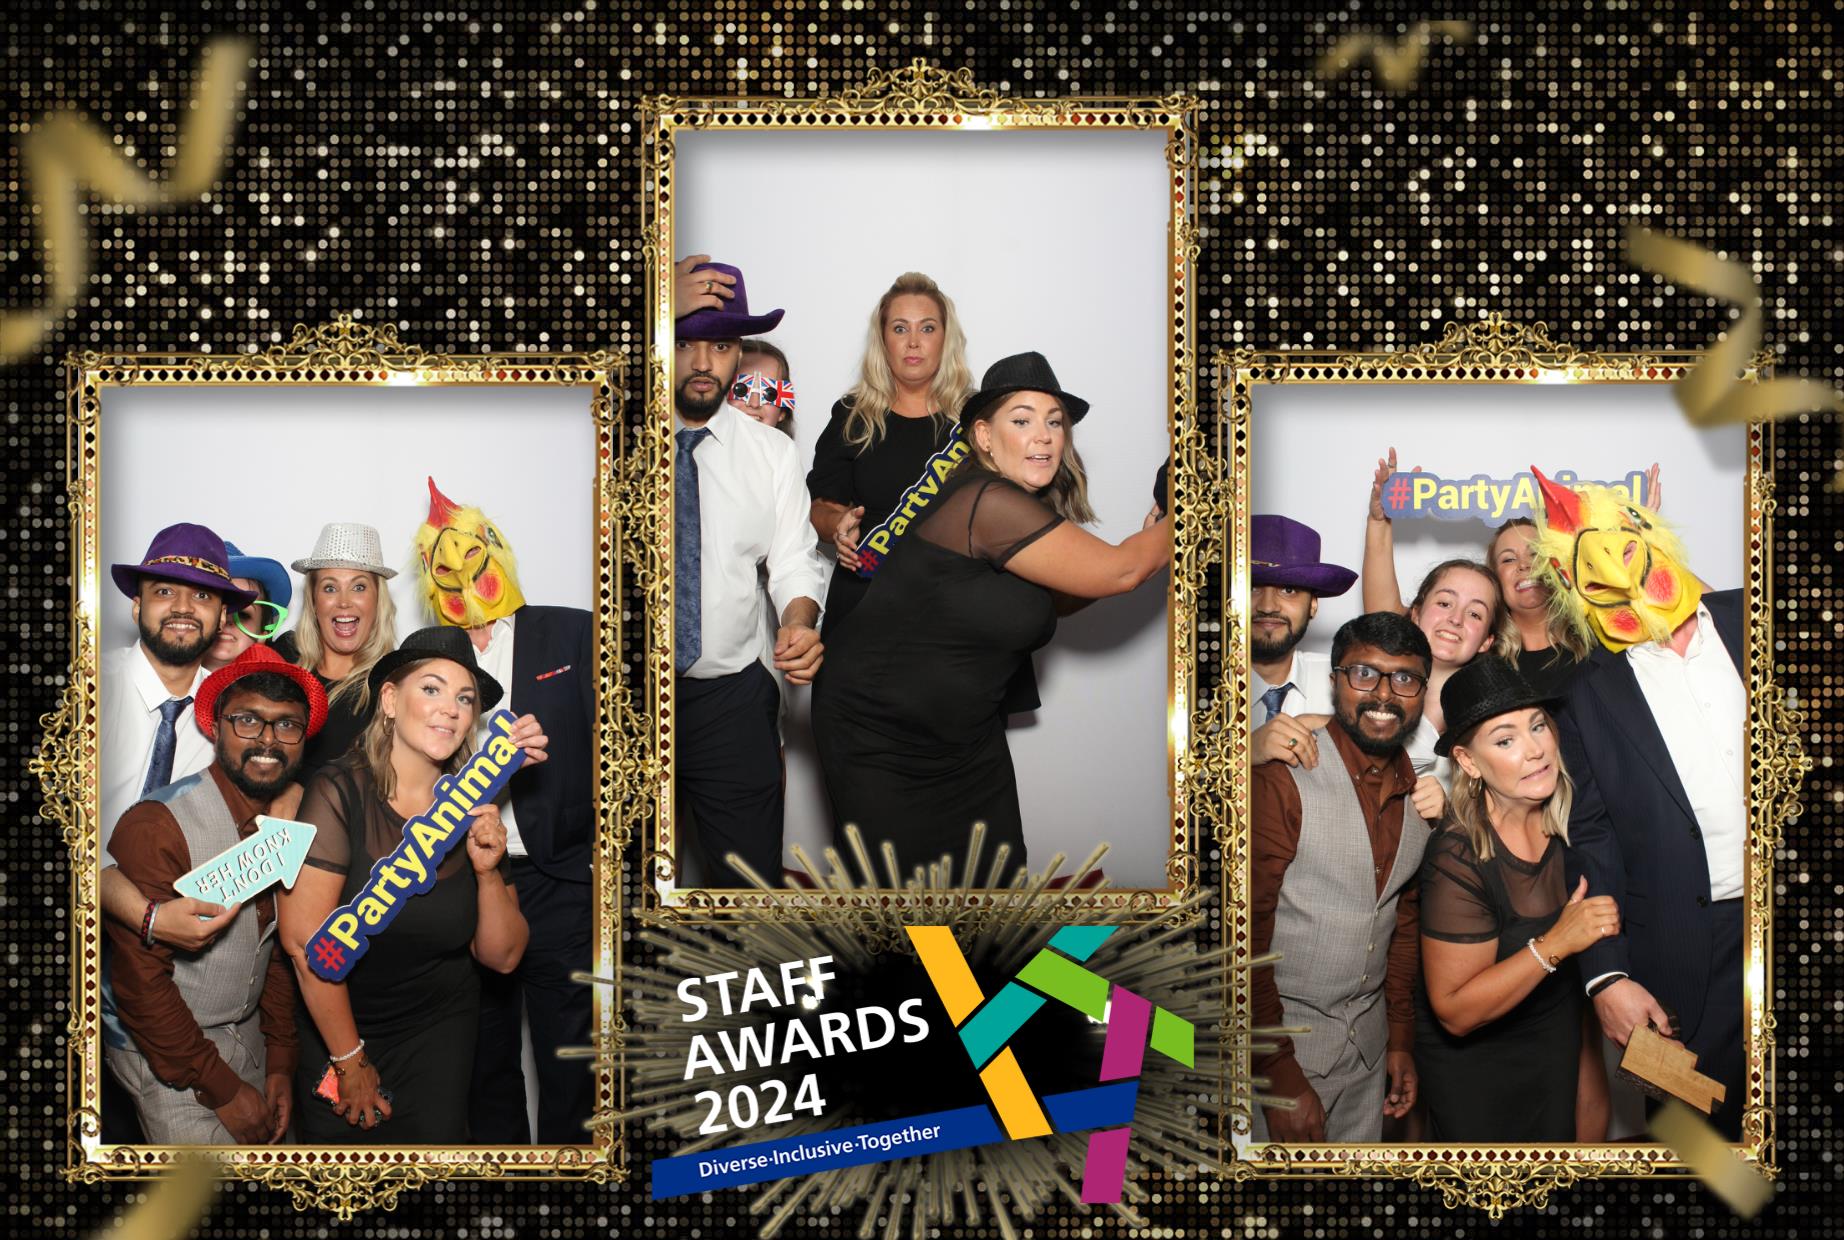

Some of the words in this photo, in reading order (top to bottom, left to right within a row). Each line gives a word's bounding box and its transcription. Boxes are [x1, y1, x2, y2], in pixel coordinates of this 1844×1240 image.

[858, 426, 971, 572] #PartyAn
[236, 827, 292, 871] KNOW
[276, 852, 285, 867] I
[313, 714, 519, 972] #PartyAnimal
[195, 862, 235, 895] HER
[219, 858, 275, 903] DON'T
